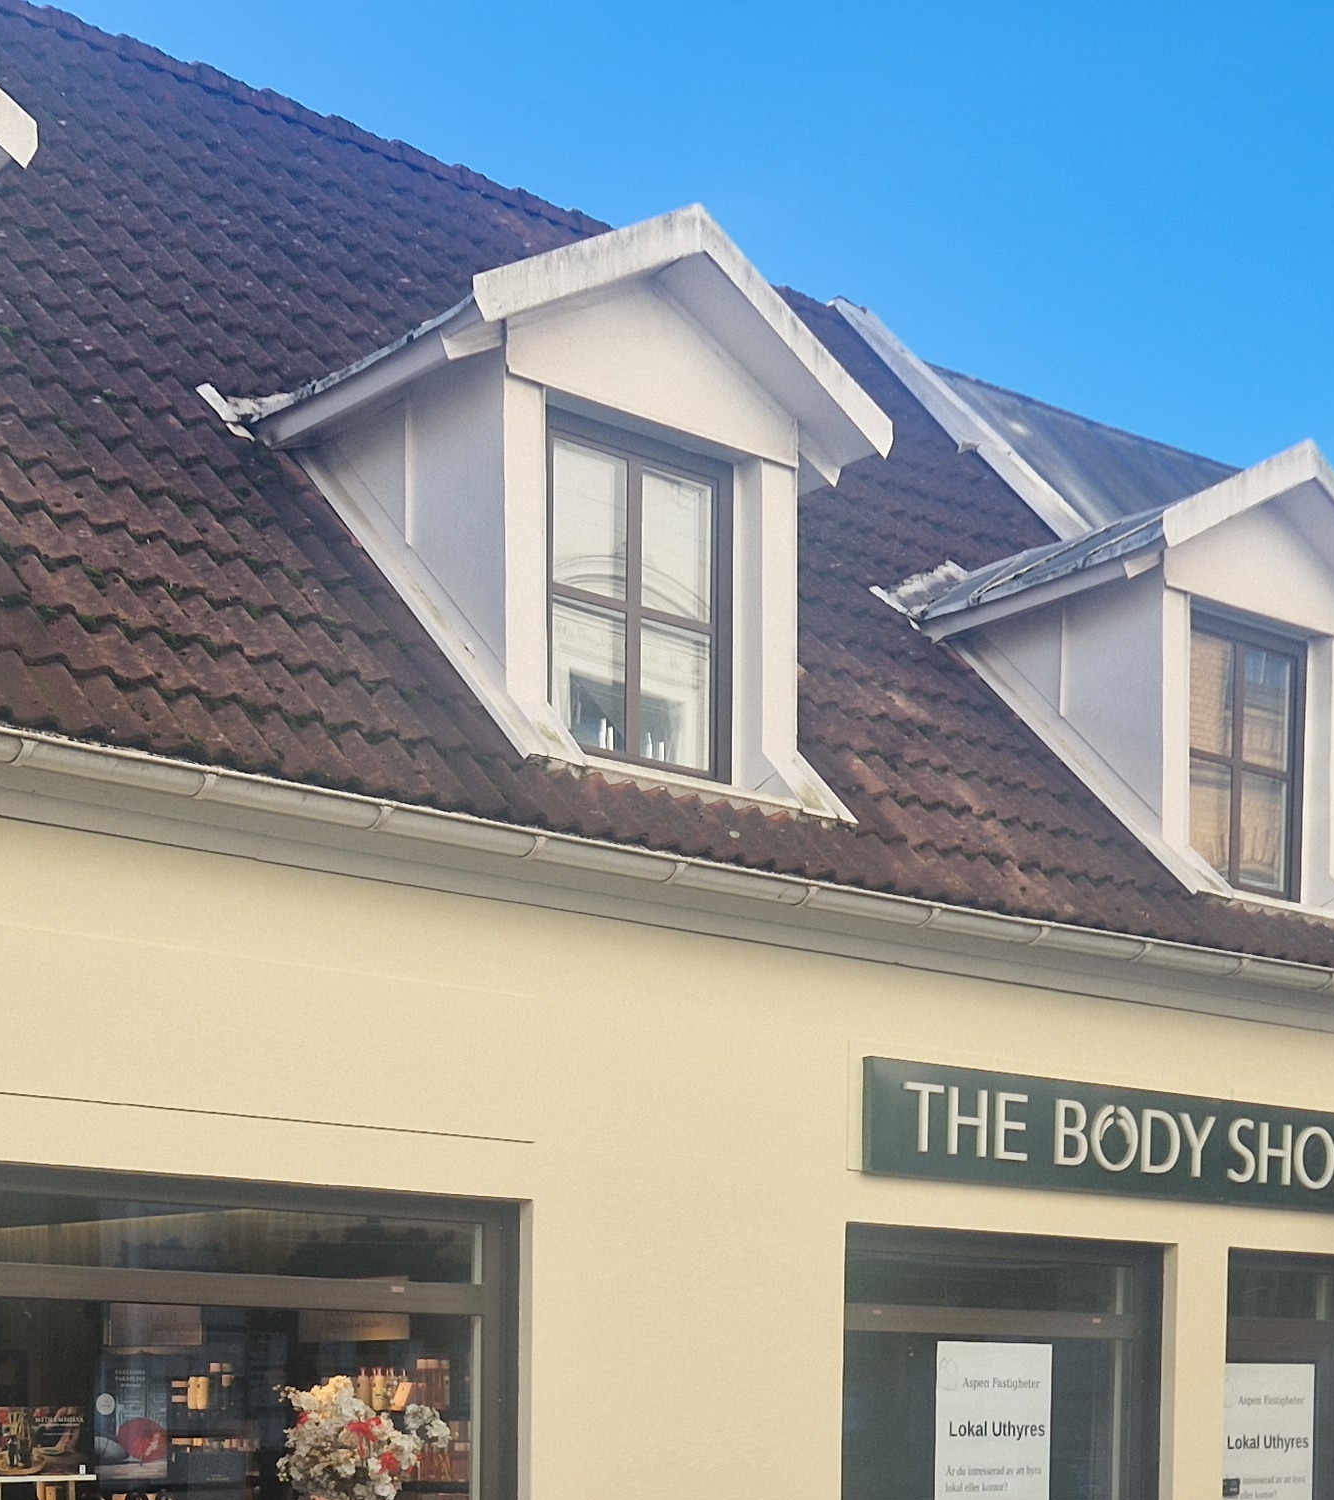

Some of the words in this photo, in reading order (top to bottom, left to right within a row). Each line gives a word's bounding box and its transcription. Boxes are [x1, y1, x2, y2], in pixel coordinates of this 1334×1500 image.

[903, 1081, 1029, 1162] THE
[1054, 1098, 1216, 1179] BODY
[962, 1376, 990, 1391] Aspen
[948, 1420, 988, 1438] Lokal
[992, 1420, 1046, 1441] Uthyres
[1227, 1434, 1260, 1450] Lokal
[1263, 1434, 1309, 1453] Uthyres
